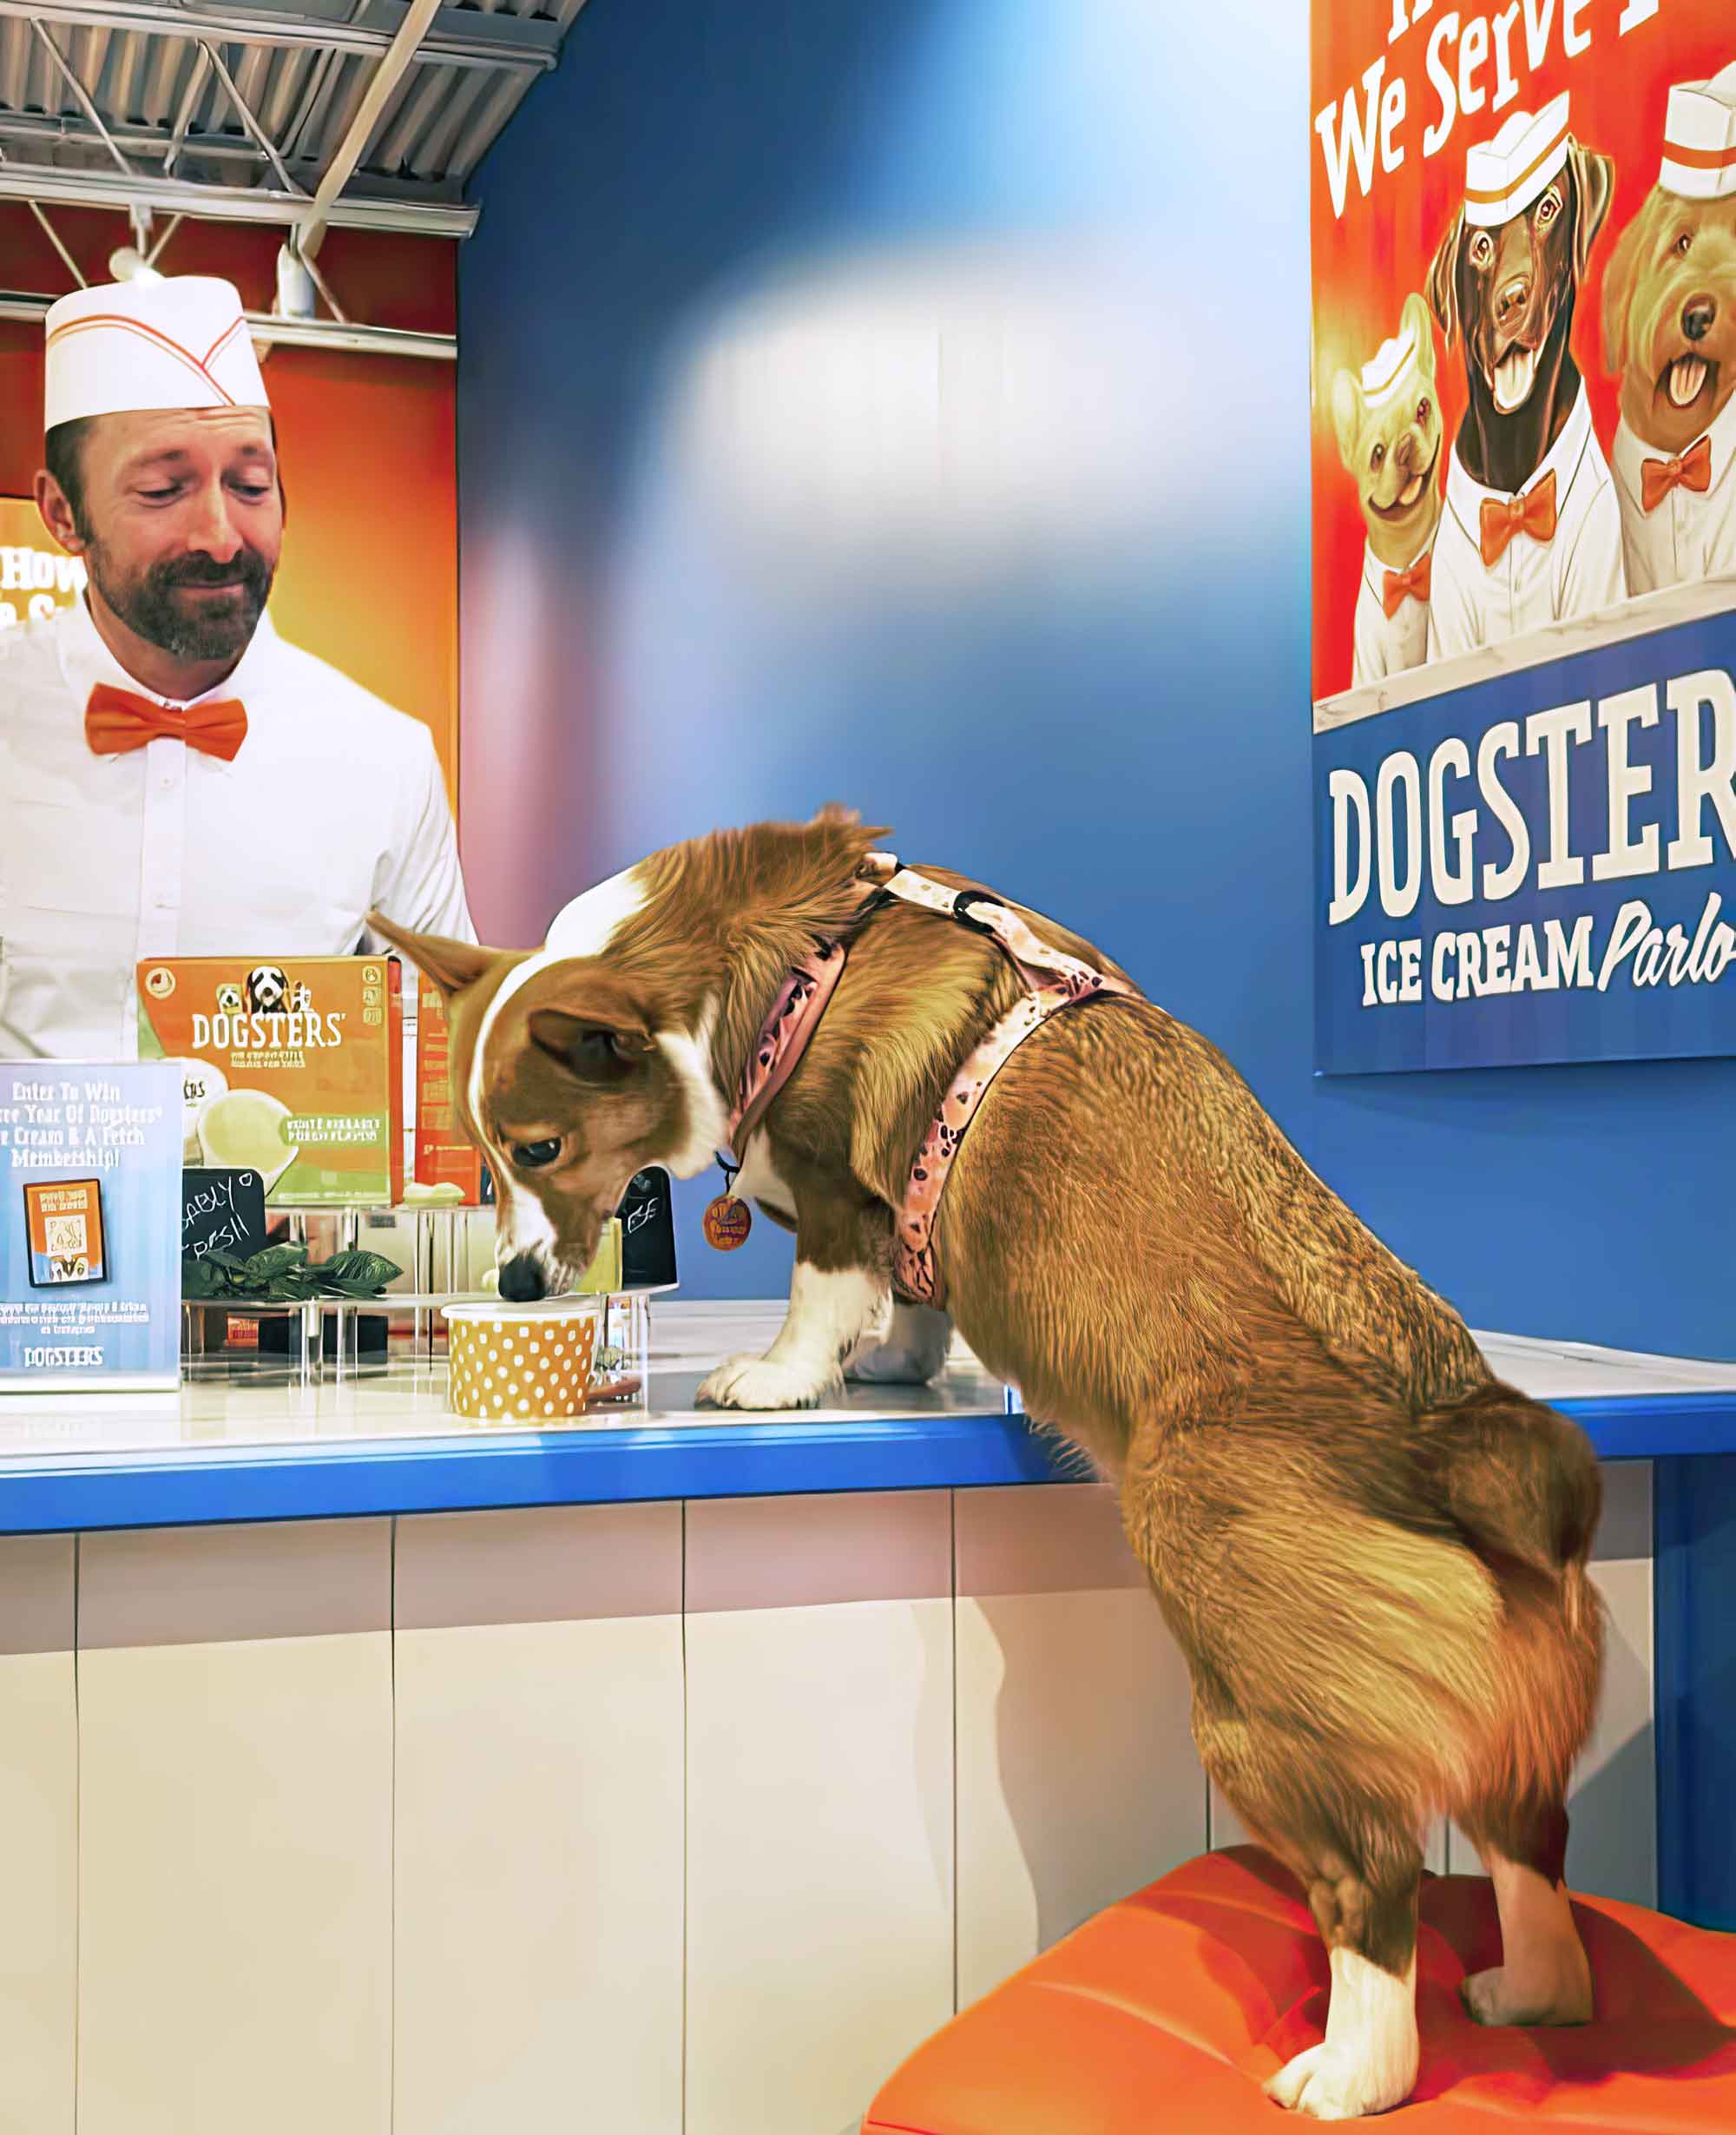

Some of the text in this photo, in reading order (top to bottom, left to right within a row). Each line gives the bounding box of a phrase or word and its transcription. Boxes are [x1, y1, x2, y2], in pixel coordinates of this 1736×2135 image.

[1314, 0, 1591, 220] We Serve
[1361, 939, 1422, 1006] ICE
[1431, 916, 1594, 1002] CREAM
